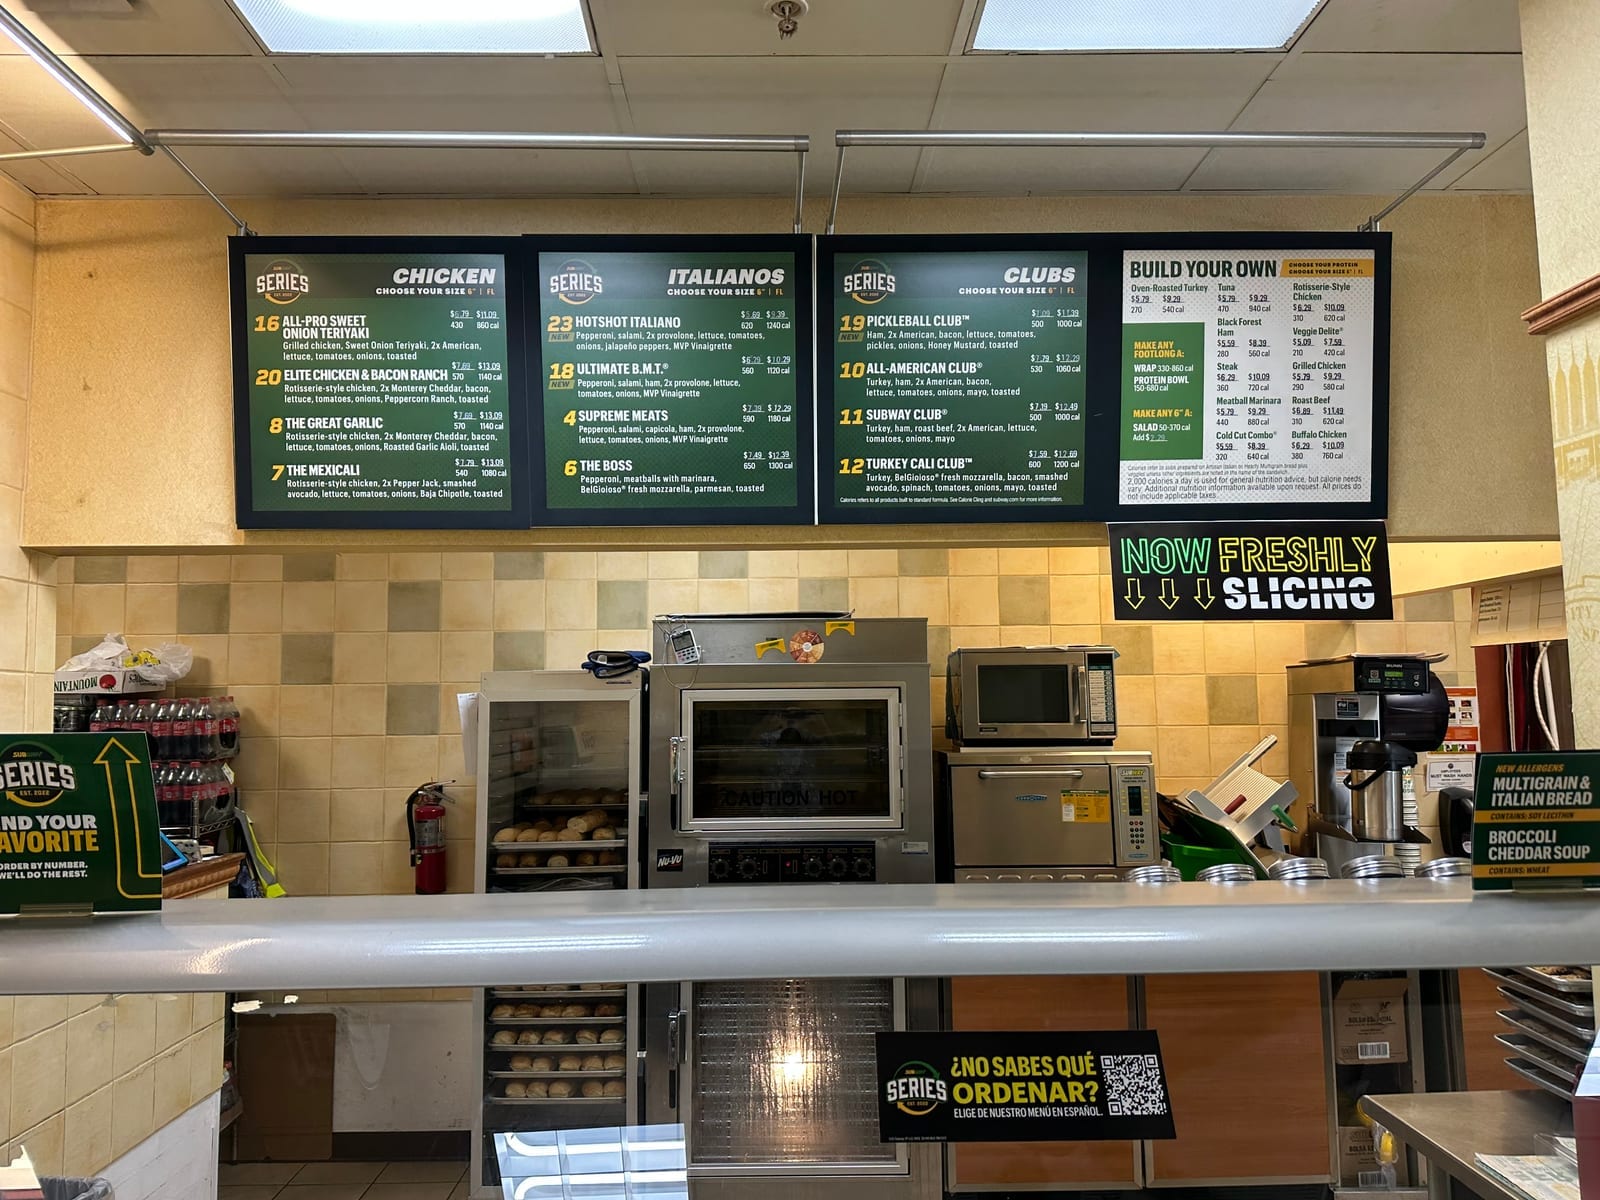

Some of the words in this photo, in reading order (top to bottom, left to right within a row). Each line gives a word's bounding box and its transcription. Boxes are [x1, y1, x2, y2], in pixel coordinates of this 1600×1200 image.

[1130, 261, 1182, 278] BUILD
[1186, 260, 1232, 277] YOUR
[1236, 260, 1276, 277] OWN
[393, 268, 496, 284] CHICKEN
[668, 269, 784, 284] ITALIANOS
[1004, 268, 1075, 283] CLUBS
[257, 273, 308, 295] SERIES
[550, 274, 602, 294] SERIES
[844, 273, 895, 294] SERIES
[1132, 284, 1182, 292] Oven-Roasted
[1184, 283, 1208, 293] Turkey
[1218, 283, 1235, 291] Tuna
[1294, 283, 1350, 292] Rotisserie-Style
[1293, 292, 1322, 300] Chicken
[255, 316, 280, 331] 16
[283, 316, 327, 326] ALL-PRO
[330, 316, 366, 326] SWEET
[548, 316, 572, 332] 23
[576, 316, 628, 327] HOTSHOT
[630, 317, 680, 328] ITALIANO
[840, 316, 865, 331] 19
[867, 316, 931, 326] PICKLEBALL
[1218, 318, 1238, 326] Black
[1239, 318, 1262, 326] Forest
[283, 327, 318, 339] ONION
[321, 326, 369, 338] TERIYAKI
[1218, 328, 1234, 336] Ham
[1293, 328, 1317, 336] Veggie
[283, 342, 308, 350] Grilled
[346, 341, 368, 349] Sweet
[371, 341, 393, 349] Onion
[1158, 341, 1174, 349] ANY
[1134, 350, 1175, 358] FOOTLONG
[1176, 350, 1184, 358] A:
[577, 364, 630, 374] ULTIMATE
[840, 363, 865, 378] 10
[867, 363, 946, 374] ALL-AMERICAN
[1134, 364, 1156, 372] WRAP
[1158, 364, 1184, 372] 330-860
[1217, 362, 1238, 370] Steak
[256, 370, 281, 385] 20
[284, 370, 312, 380] ELITE
[313, 369, 359, 380] CHICKEN
[361, 369, 369, 380] &
[371, 369, 408, 380] BACON
[410, 370, 448, 380] RANCH
[550, 364, 574, 381] 18
[1134, 376, 1166, 384] PROTEIN
[1168, 376, 1189, 384] BOWL
[1217, 397, 1248, 405] Meatball
[1292, 396, 1312, 404] Roast
[1314, 396, 1330, 404] Beef
[564, 410, 576, 426] 4
[578, 410, 630, 421] SUPREME
[632, 410, 668, 421] MEATS
[840, 409, 863, 424] 11
[866, 410, 911, 420] SUBWAY
[270, 418, 283, 433] 8
[285, 418, 306, 428] THE
[308, 418, 342, 428] GREAT
[344, 418, 383, 428] GARLIC
[1133, 423, 1158, 431] SALAD
[1292, 430, 1317, 438] Buffalo
[1318, 430, 1347, 438] Chicken
[564, 460, 577, 476] 6
[580, 460, 600, 471] THE
[603, 460, 632, 471] BOSS
[840, 459, 864, 474] 12
[866, 458, 908, 469] TURKEY
[911, 458, 934, 469] CALI
[272, 465, 284, 480] 7
[286, 465, 307, 476] THE
[309, 465, 360, 476] MEXICALI
[1121, 538, 1211, 574] NOW
[1219, 537, 1376, 572] FRESHLY
[1223, 577, 1374, 609] SLICING
[1493, 776, 1578, 791] MULTIGRAIN
[1580, 776, 1590, 789] &
[1492, 792, 1545, 807] ITALIAN
[1546, 792, 1592, 806] BREAD
[36, 814, 98, 830] YOUR
[1489, 830, 1556, 844] BROCCOLI
[1489, 846, 1551, 860] CHEDDAR
[1554, 846, 1590, 859] SOUP
[951, 1057, 989, 1077] ¿NO
[992, 1056, 1054, 1076] SABES
[1057, 1051, 1096, 1078] QUÉ
[888, 1078, 946, 1104] SERIES
[953, 1081, 1098, 1106] ORDENAR?
[954, 1108, 976, 1118] ELIGE
[978, 1108, 988, 1118] DE
[990, 1108, 1026, 1117] NUESTRO
[1028, 1106, 1051, 1117] MENÚ
[1052, 1107, 1063, 1116] EN
